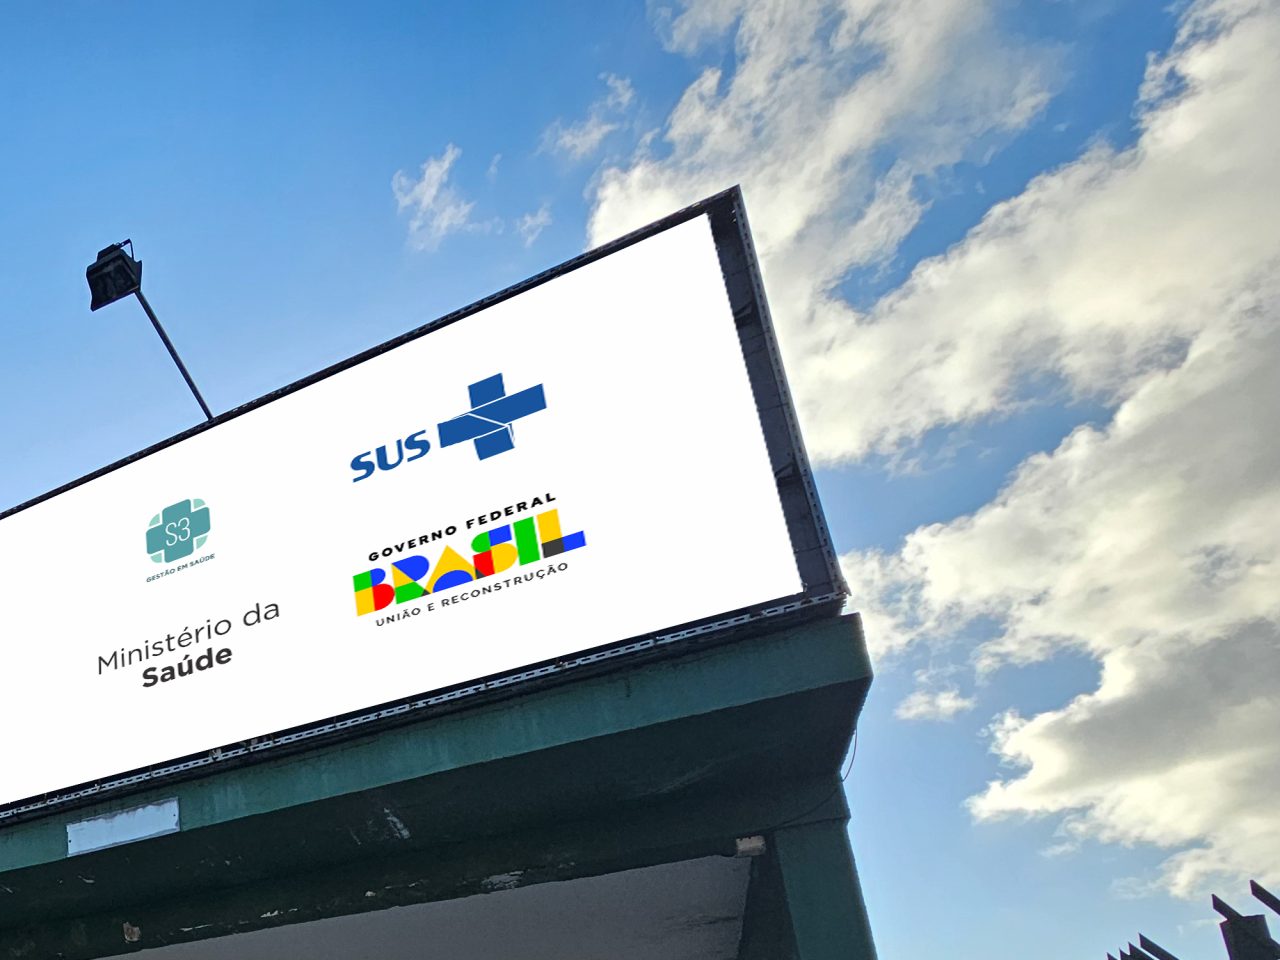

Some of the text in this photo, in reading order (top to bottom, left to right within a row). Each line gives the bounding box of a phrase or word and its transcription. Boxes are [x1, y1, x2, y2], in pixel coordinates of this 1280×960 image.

[349, 429, 431, 483] SUS
[165, 517, 191, 547] S3
[368, 492, 557, 562] GOVERNO FEDERAL
[146, 553, 216, 583] GESTÃO EM SAÚDE
[352, 508, 587, 617] BRASIL
[375, 562, 568, 627] UNIÃO E RECONSTRUÇÃO
[98, 602, 280, 675] Ministério da
[142, 646, 233, 688] Saúde
